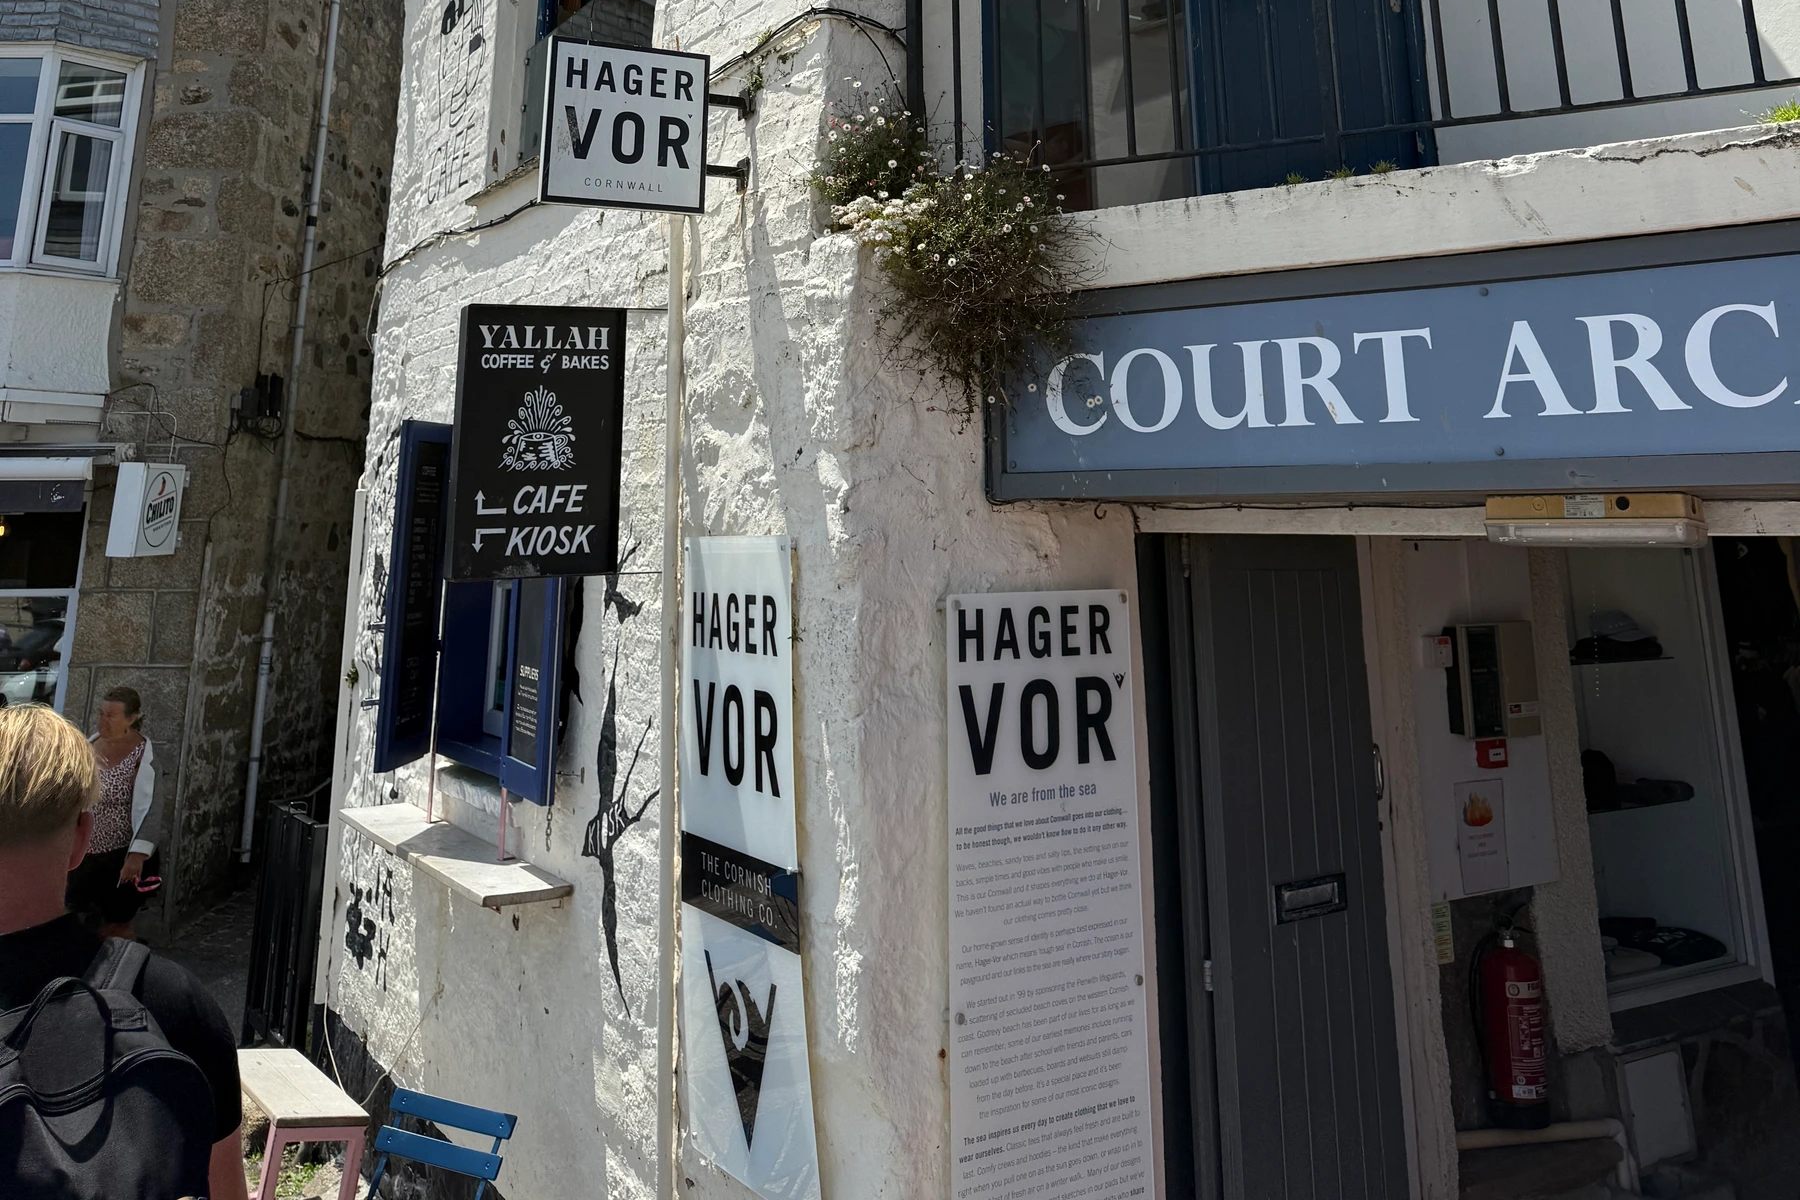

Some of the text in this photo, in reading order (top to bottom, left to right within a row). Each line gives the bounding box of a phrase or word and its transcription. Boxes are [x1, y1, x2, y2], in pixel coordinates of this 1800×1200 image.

[565, 57, 694, 102] HAGER
[565, 105, 690, 170] VOR
[583, 176, 664, 194] CORNWALL
[479, 324, 609, 349] YALLAH
[481, 351, 609, 373] COFFEE & BAKES
[1045, 300, 1800, 436] COURT ARC
[146, 496, 175, 524] CHILITO
[513, 484, 589, 514] CAFE
[505, 524, 596, 556] KIOSK
[692, 591, 778, 657] HAGER
[958, 604, 1112, 663] HAGER
[693, 679, 781, 798] VOR
[958, 676, 1116, 776] VOR
[1010, 791, 1028, 803] are
[1031, 785, 1055, 801] from
[1058, 783, 1075, 797] the
[1078, 783, 1096, 795] sea
[588, 795, 626, 854] KIOSK
[955, 826, 963, 835] All
[963, 825, 972, 834] the
[973, 823, 986, 834] good
[987, 821, 1003, 833] things
[1003, 820, 1014, 829] that
[1023, 817, 1034, 826] love
[1034, 815, 1049, 825] about
[1049, 812, 1071, 823] Cornwall
[1071, 812, 1084, 821] goes
[1084, 810, 1094, 818] into
[971, 838, 990, 848] honest
[1022, 830, 1045, 841] wouldn't
[1045, 828, 1060, 838] know
[1060, 827, 1072, 835] how
[1091, 824, 1101, 833] any
[1101, 821, 1115, 830] other
[701, 851, 773, 897] THE CORNISH
[701, 878, 778, 929] CLOTHING CO.
[963, 1134, 974, 1146] The
[975, 1133, 987, 1143] sea
[987, 1126, 1011, 1141] inspires
[1020, 1120, 1036, 1133] every
[1036, 1116, 1047, 1128] day
[1055, 1110, 1073, 1122] create
[1073, 1103, 1096, 1119] clothing
[1096, 1100, 1108, 1111] that
[1117, 1095, 1129, 1105] love
